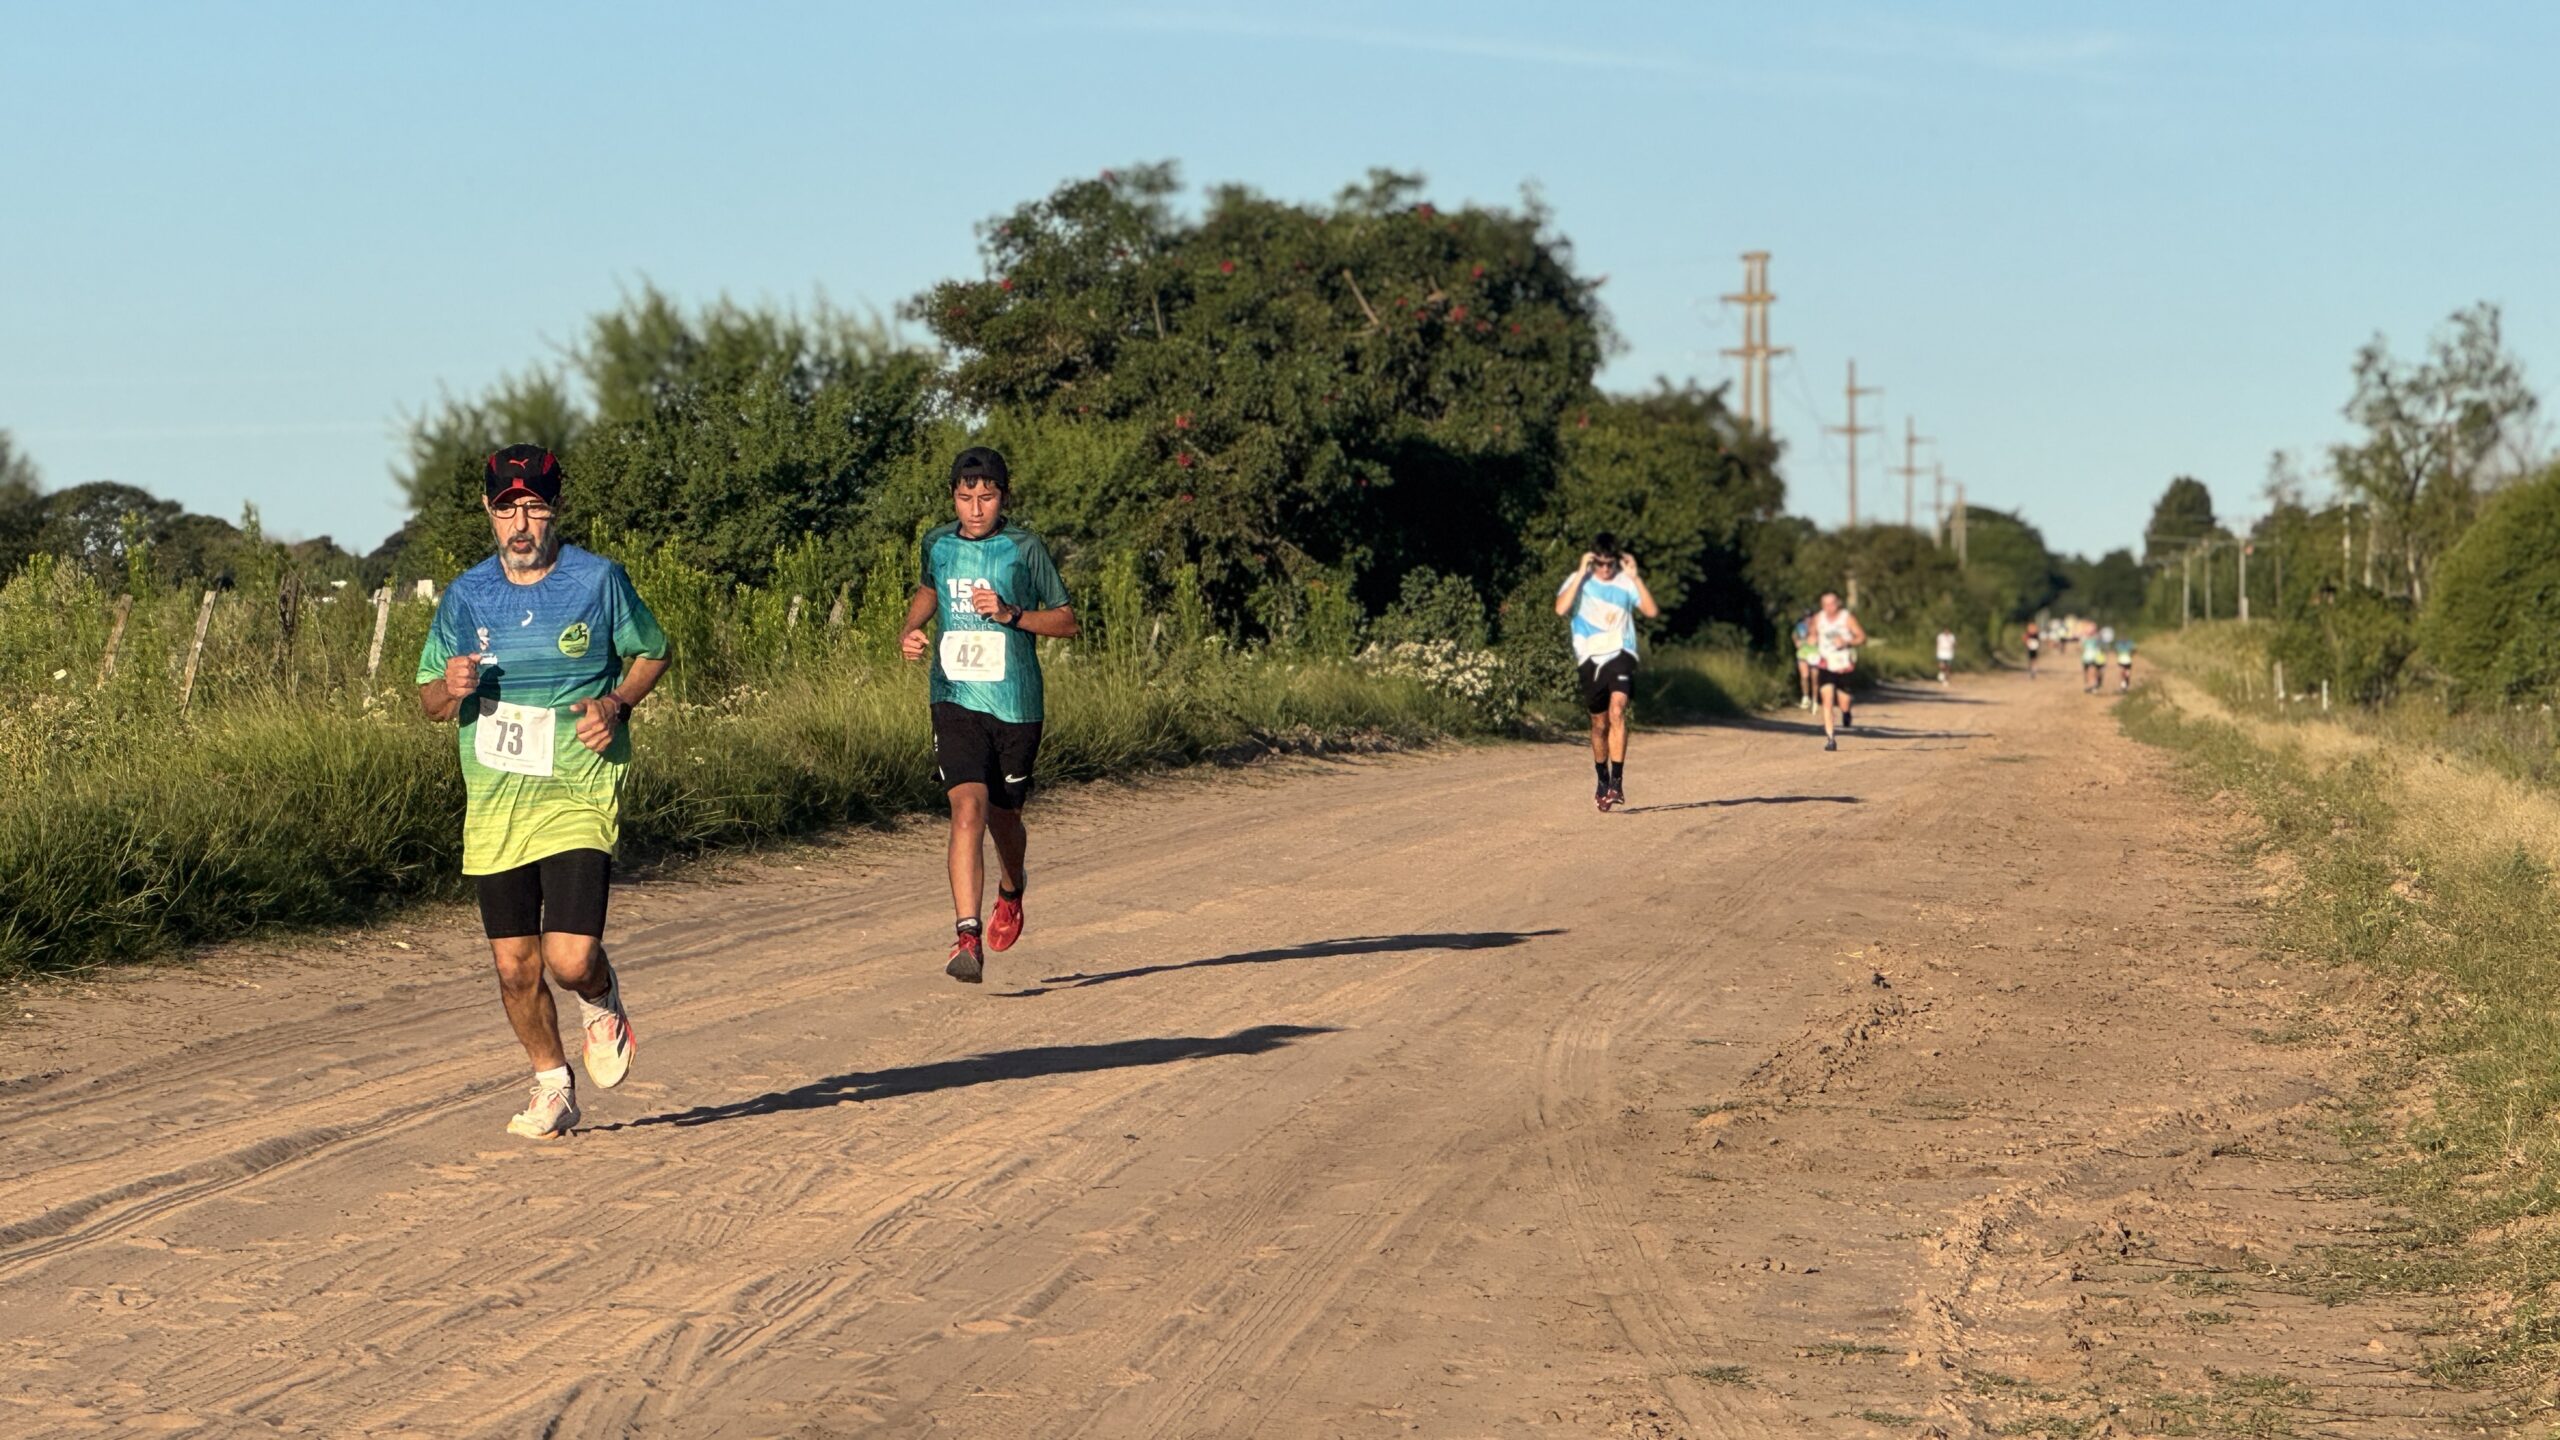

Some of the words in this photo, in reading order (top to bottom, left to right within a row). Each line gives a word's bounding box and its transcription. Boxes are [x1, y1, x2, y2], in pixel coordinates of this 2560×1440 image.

[951, 599, 975, 613] AÑ
[956, 644, 984, 667] 42
[496, 720, 523, 755] 73
